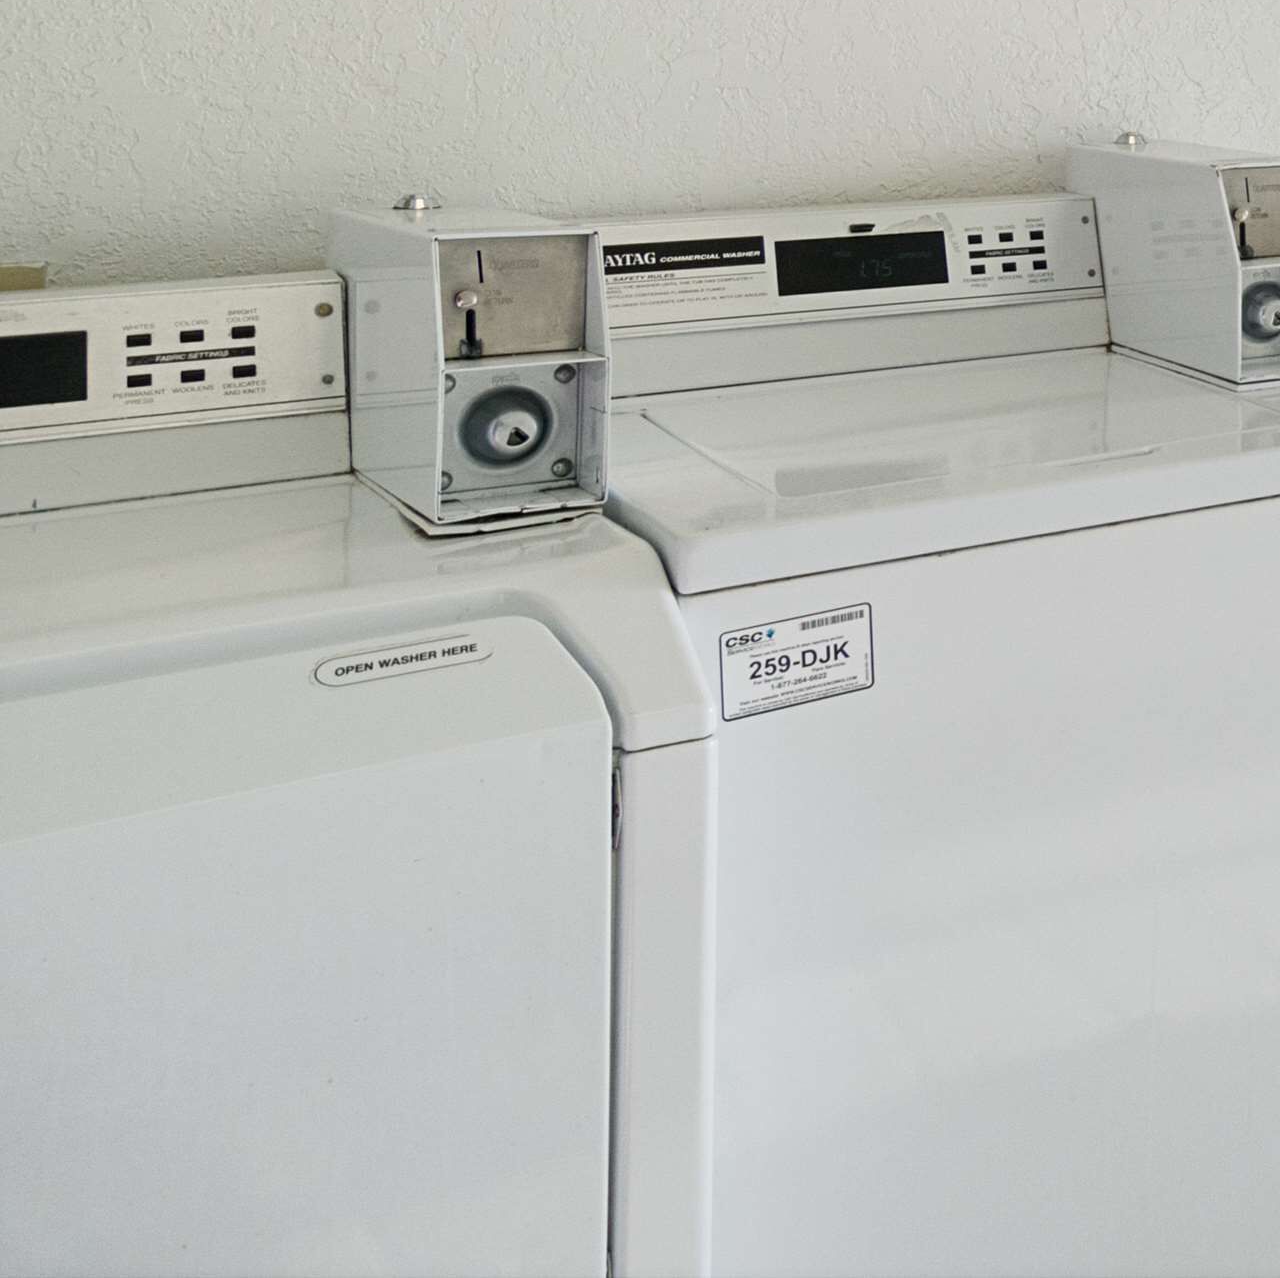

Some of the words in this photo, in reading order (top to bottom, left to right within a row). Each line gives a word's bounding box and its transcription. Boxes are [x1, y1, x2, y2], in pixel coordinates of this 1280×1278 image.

[604, 251, 656, 267] AYTAG
[659, 254, 720, 263] COMMERCIAL
[722, 250, 761, 259] WASHER
[228, 308, 257, 316] BRIGHT
[155, 354, 185, 362] FABRIC
[188, 350, 229, 360] SETTINGS
[172, 385, 214, 394] WOOLENS
[222, 379, 267, 389] DELICATES
[113, 389, 165, 399] PERMANENT
[242, 387, 266, 395] KNITS
[725, 631, 763, 648] CSC
[334, 662, 373, 677] OPEN
[379, 650, 438, 668] WASHER
[442, 643, 478, 657] HERE
[749, 640, 850, 680] 259-DJK
